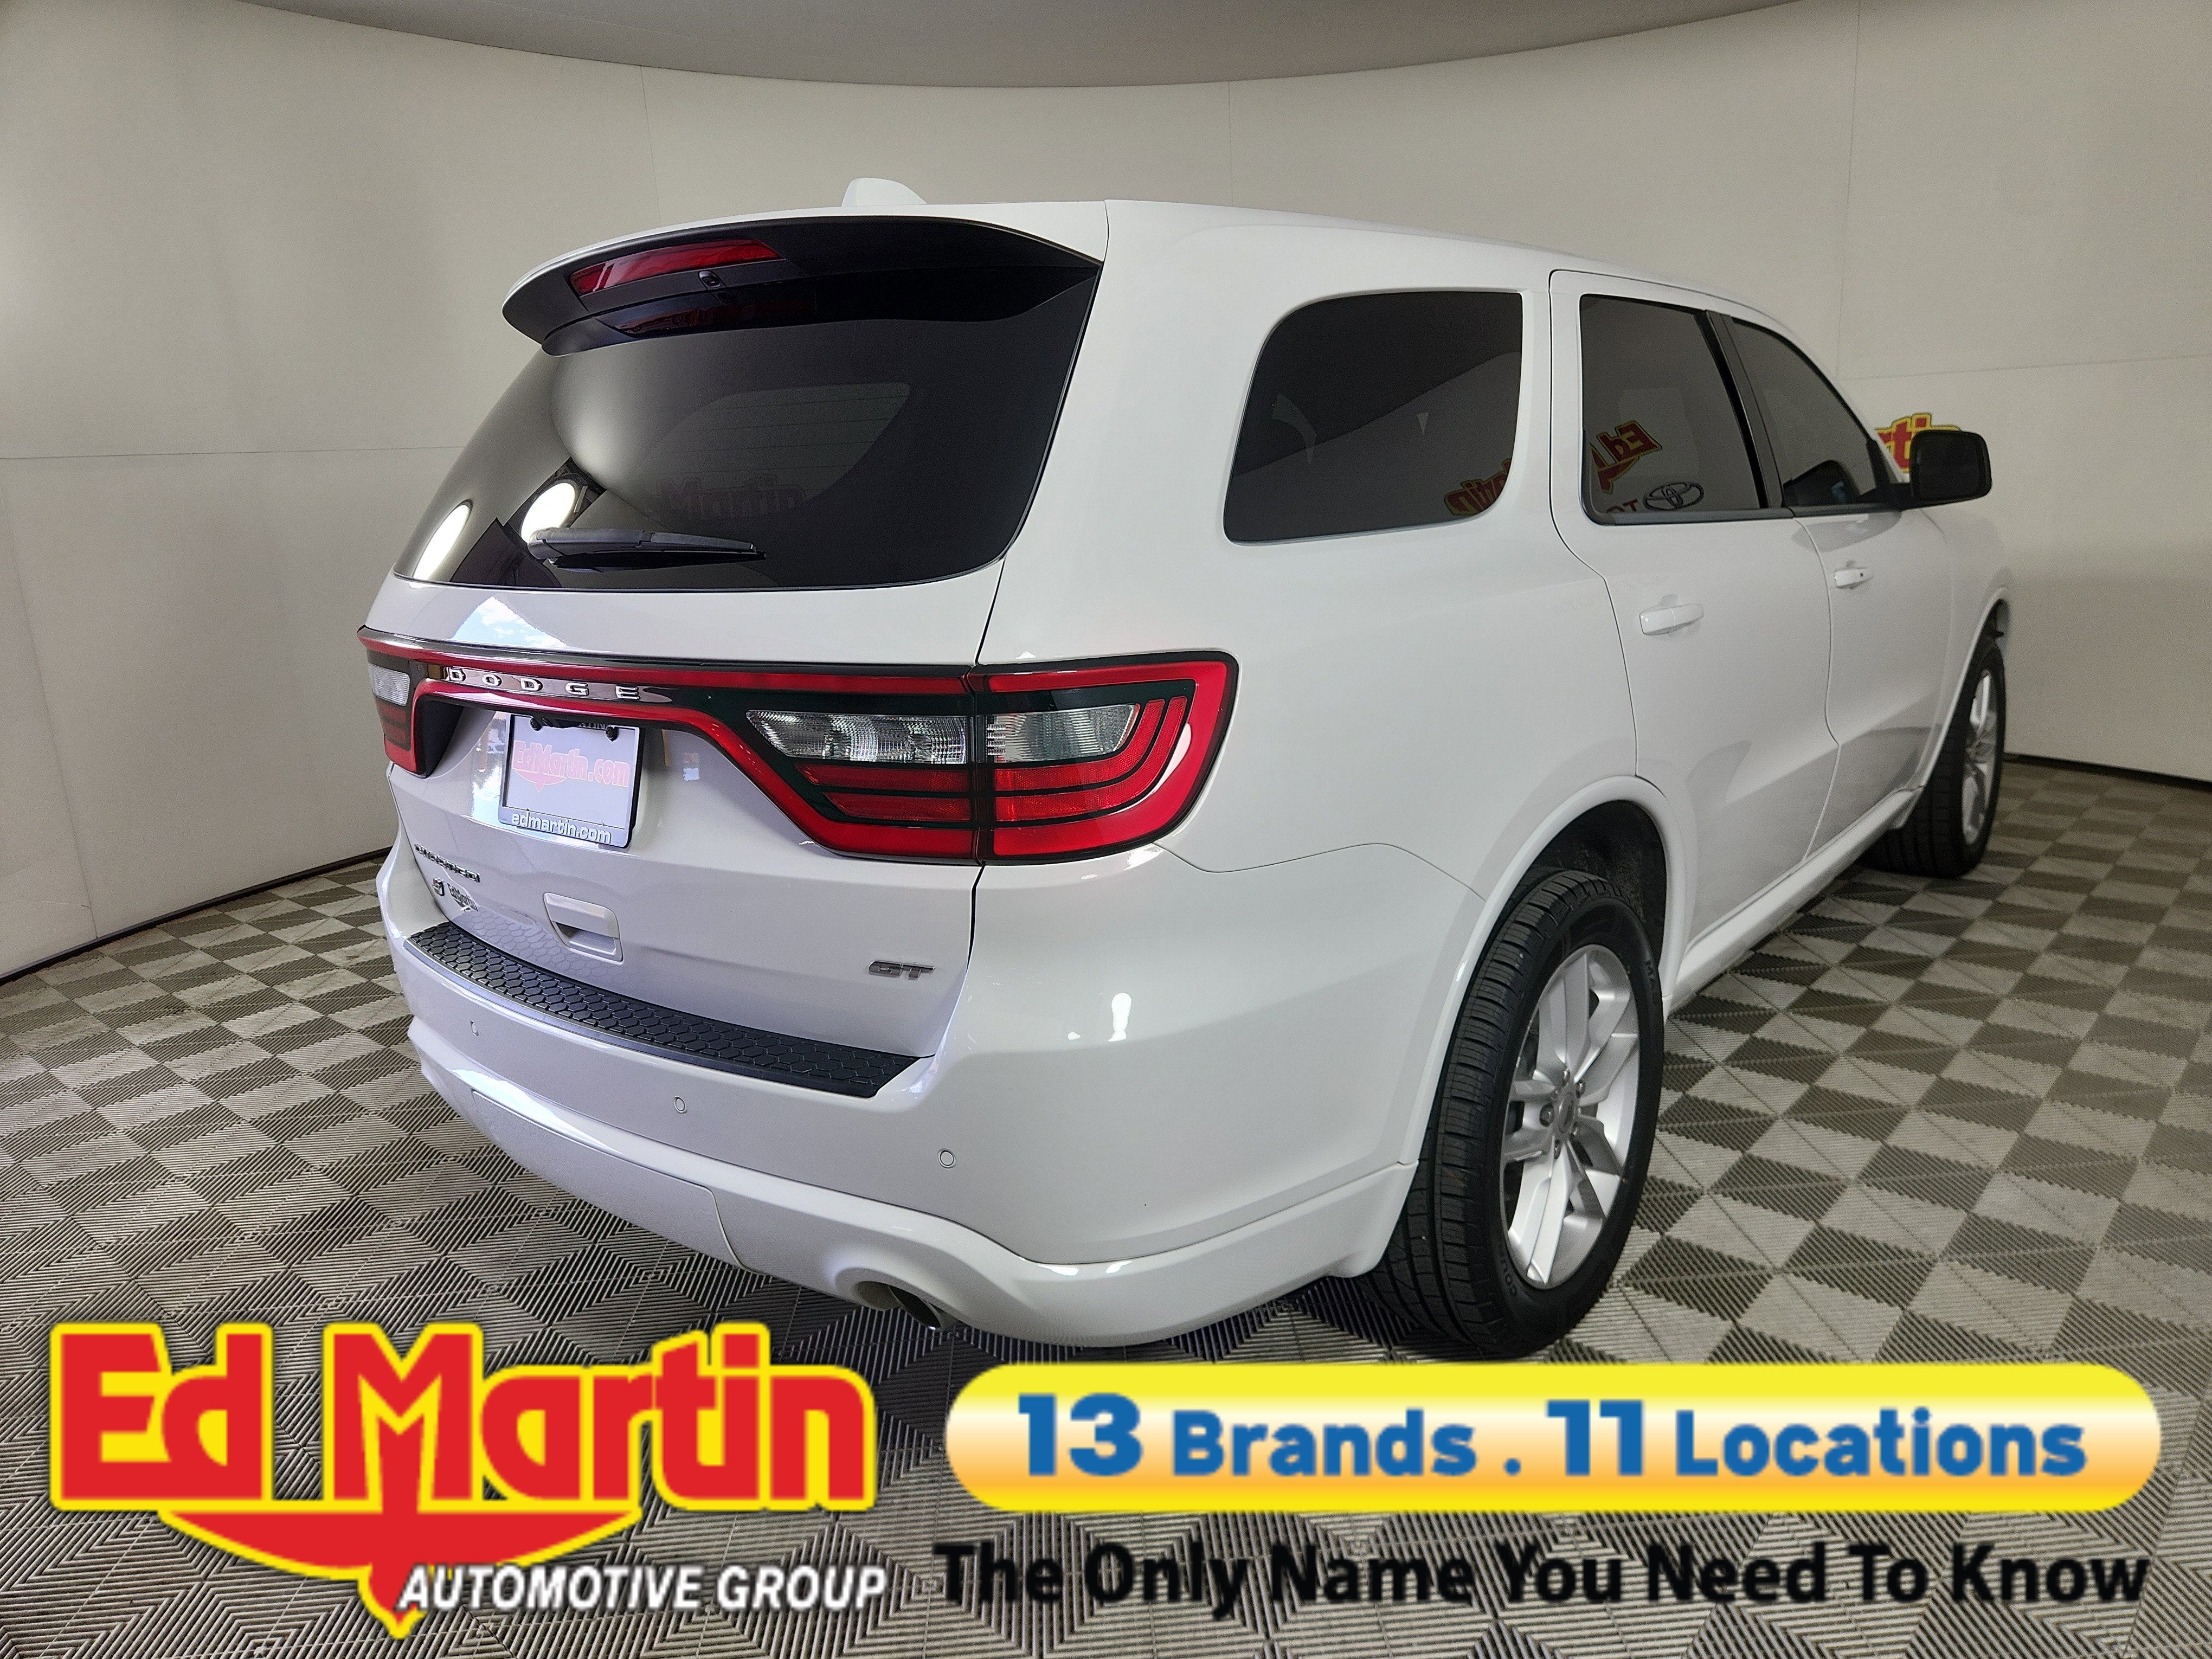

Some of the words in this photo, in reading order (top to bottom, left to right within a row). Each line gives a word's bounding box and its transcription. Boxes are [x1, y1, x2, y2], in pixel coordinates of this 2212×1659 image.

[448, 666, 640, 700] DODGE
[512, 812, 612, 844] edmartin.com
[869, 953, 935, 980] GT
